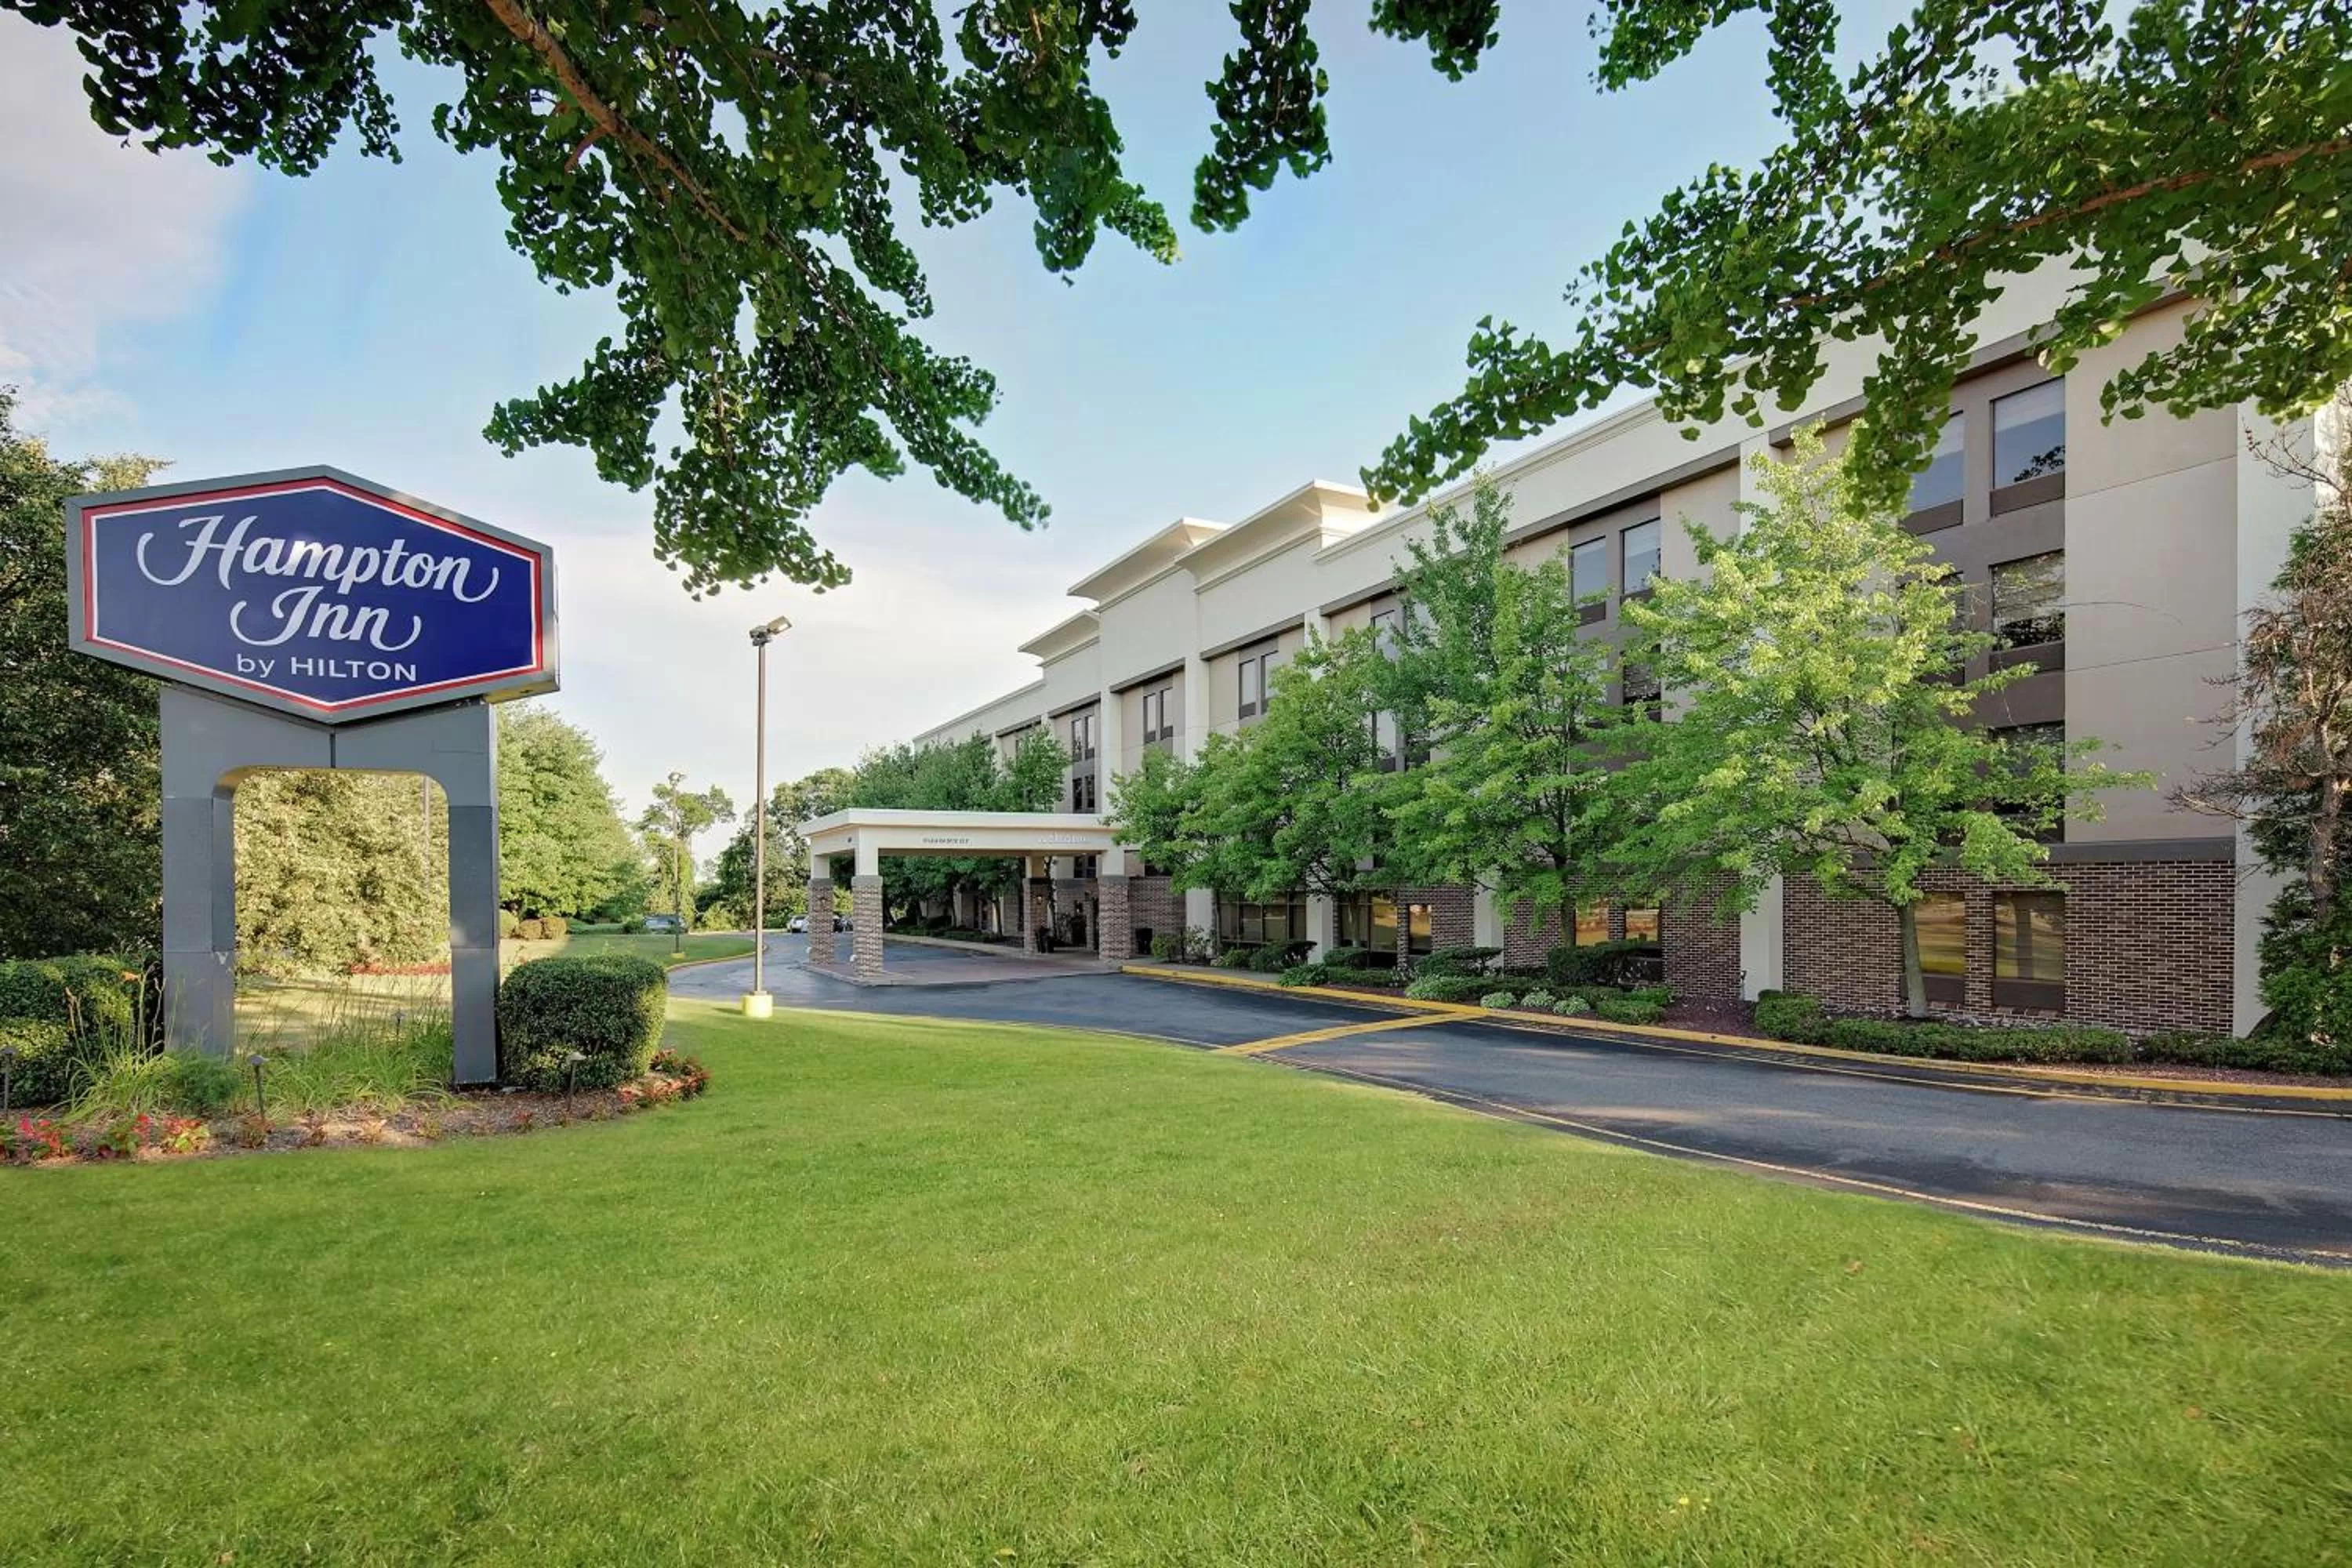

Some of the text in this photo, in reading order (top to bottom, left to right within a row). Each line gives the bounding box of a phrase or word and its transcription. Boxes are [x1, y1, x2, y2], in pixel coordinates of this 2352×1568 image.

[136, 514, 499, 603] Hampton
[230, 585, 422, 652] Inn
[236, 653, 417, 682] by HILTON
